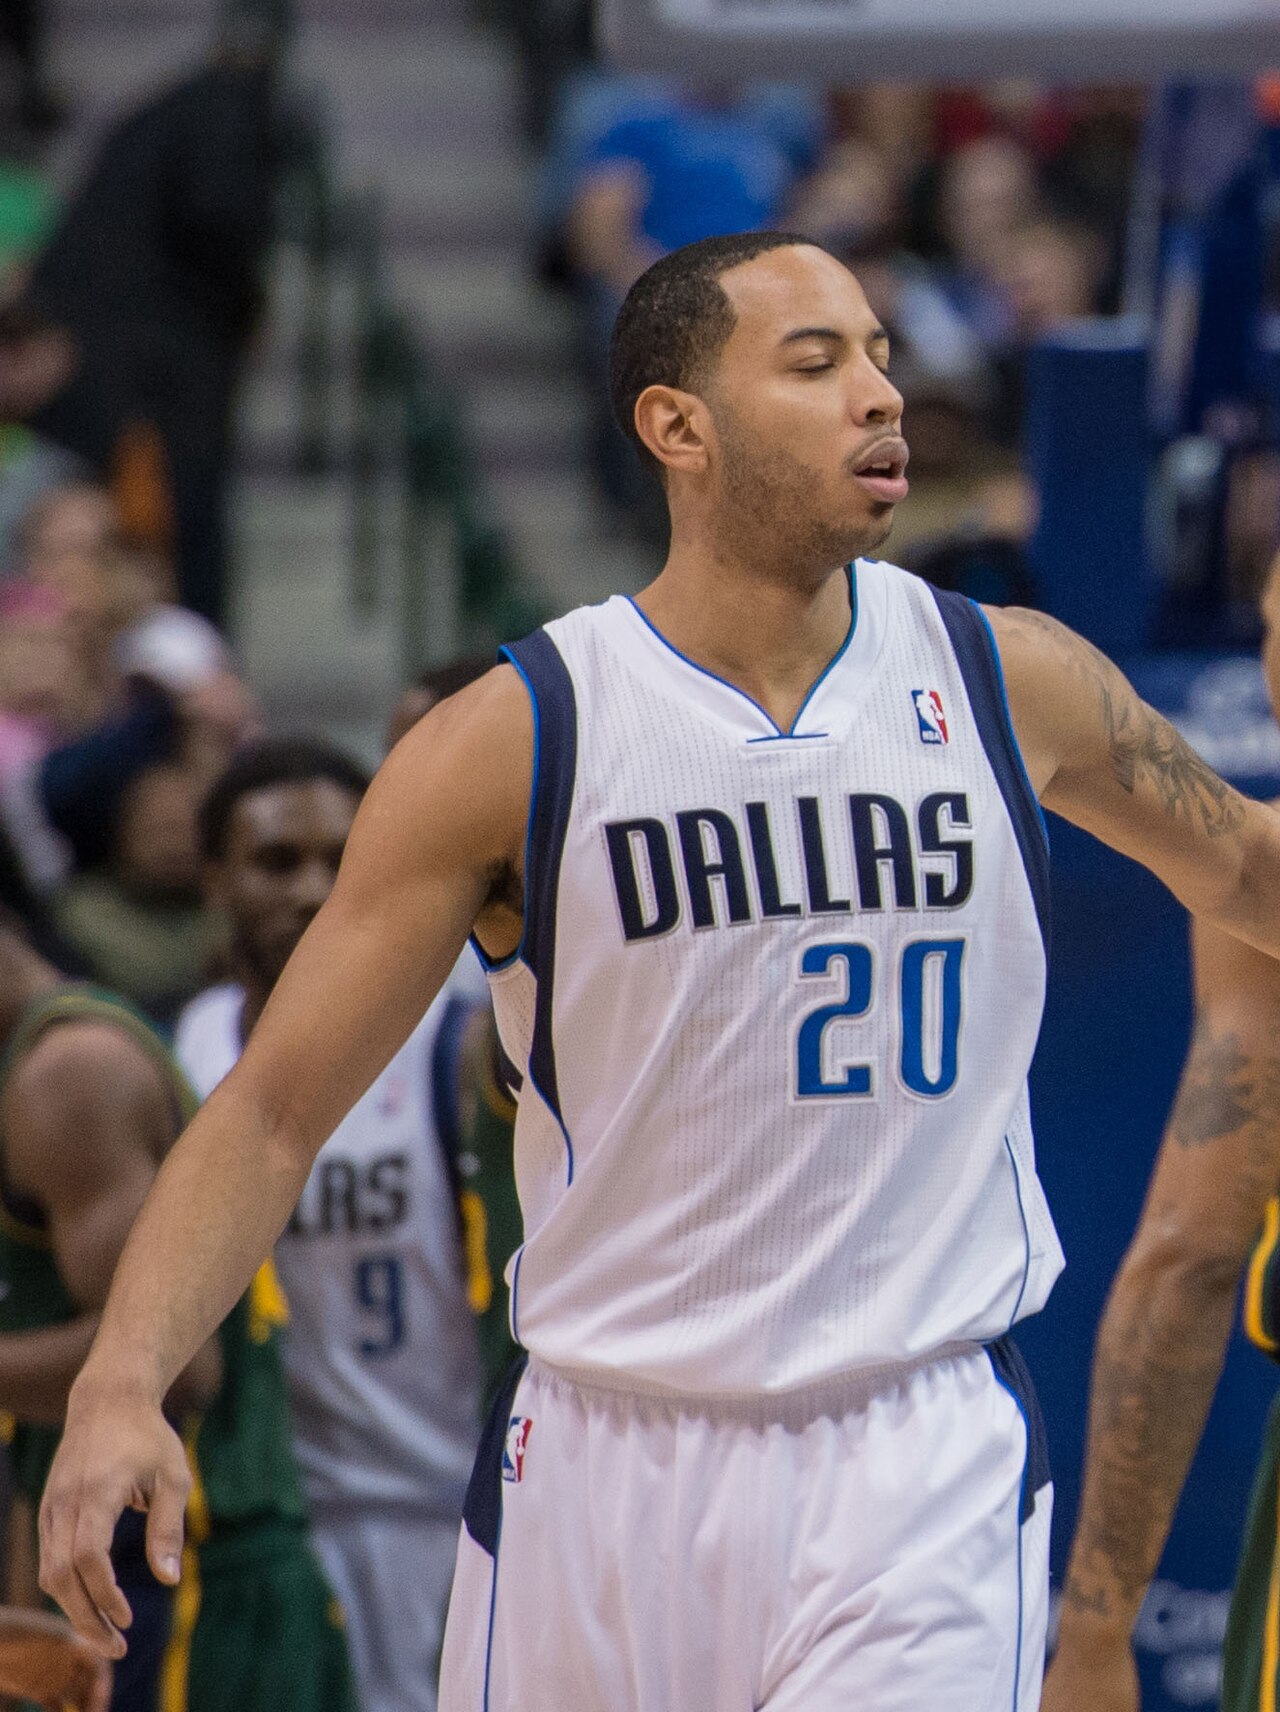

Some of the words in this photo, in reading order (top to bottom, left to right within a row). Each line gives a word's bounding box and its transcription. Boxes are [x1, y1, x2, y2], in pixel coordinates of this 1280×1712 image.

[603, 791, 974, 945] DALLAS
[792, 933, 969, 1102] 20
[355, 1256, 403, 1358] 9
